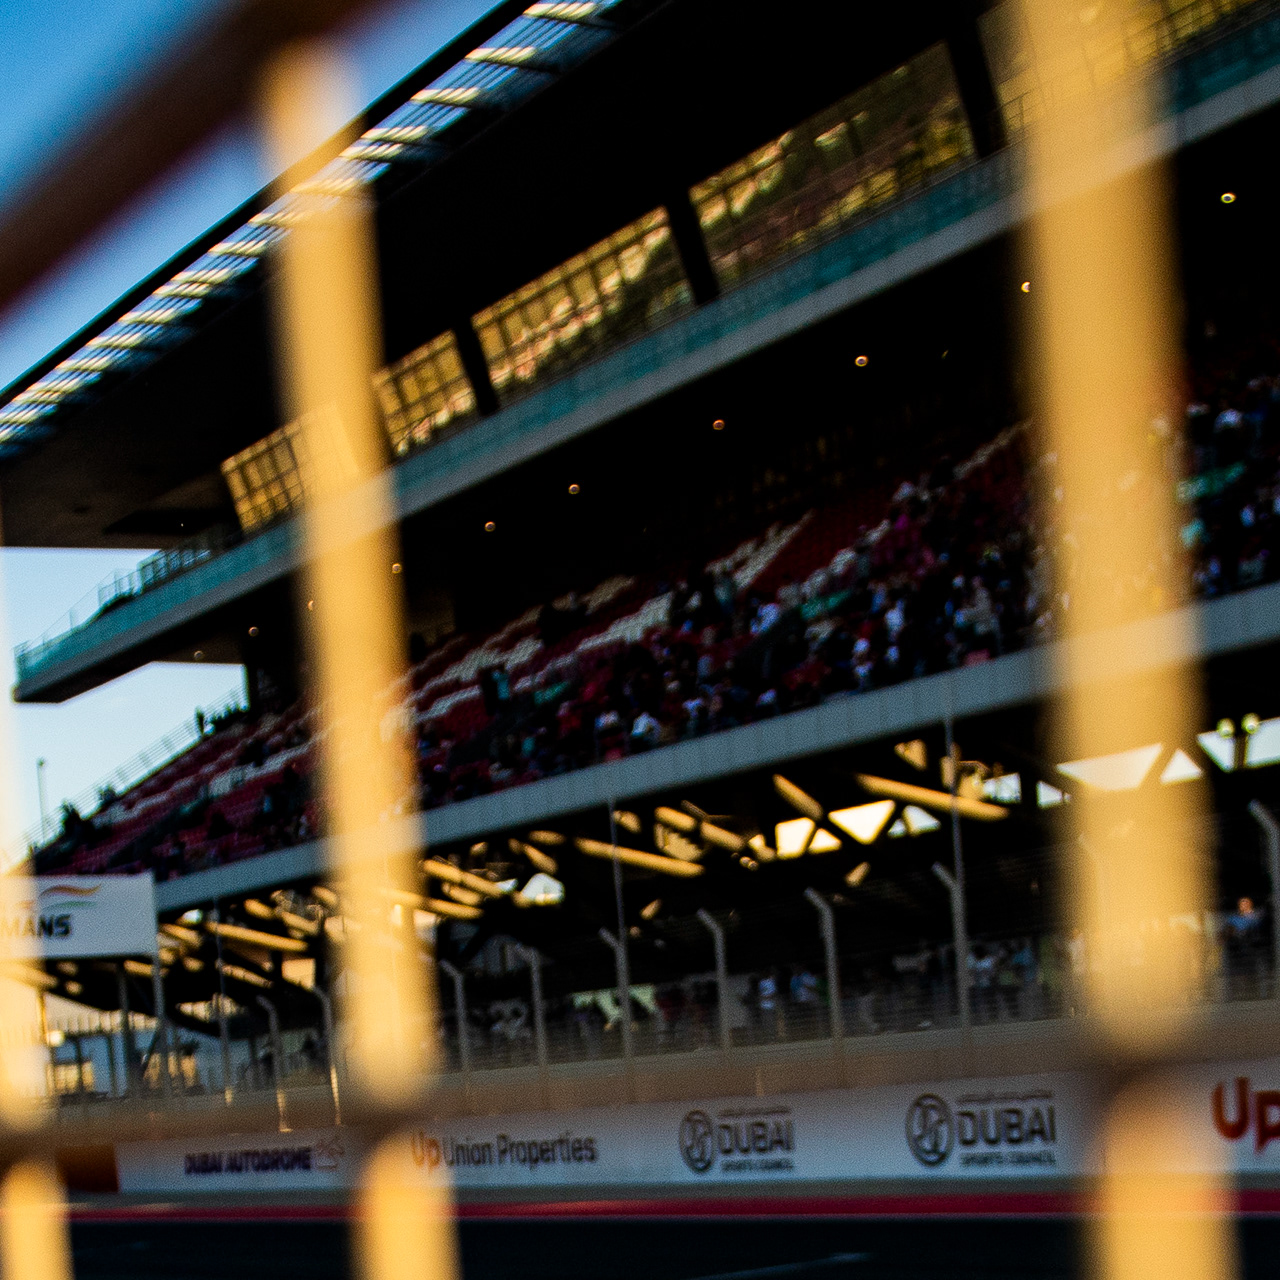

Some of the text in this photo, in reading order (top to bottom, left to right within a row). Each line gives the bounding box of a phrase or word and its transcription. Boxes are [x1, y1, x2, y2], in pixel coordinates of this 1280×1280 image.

[718, 1121, 794, 1155] DUBAI
[957, 1105, 1056, 1146] DUBAI
[443, 1135, 494, 1166] Union
[496, 1131, 598, 1171] Properties
